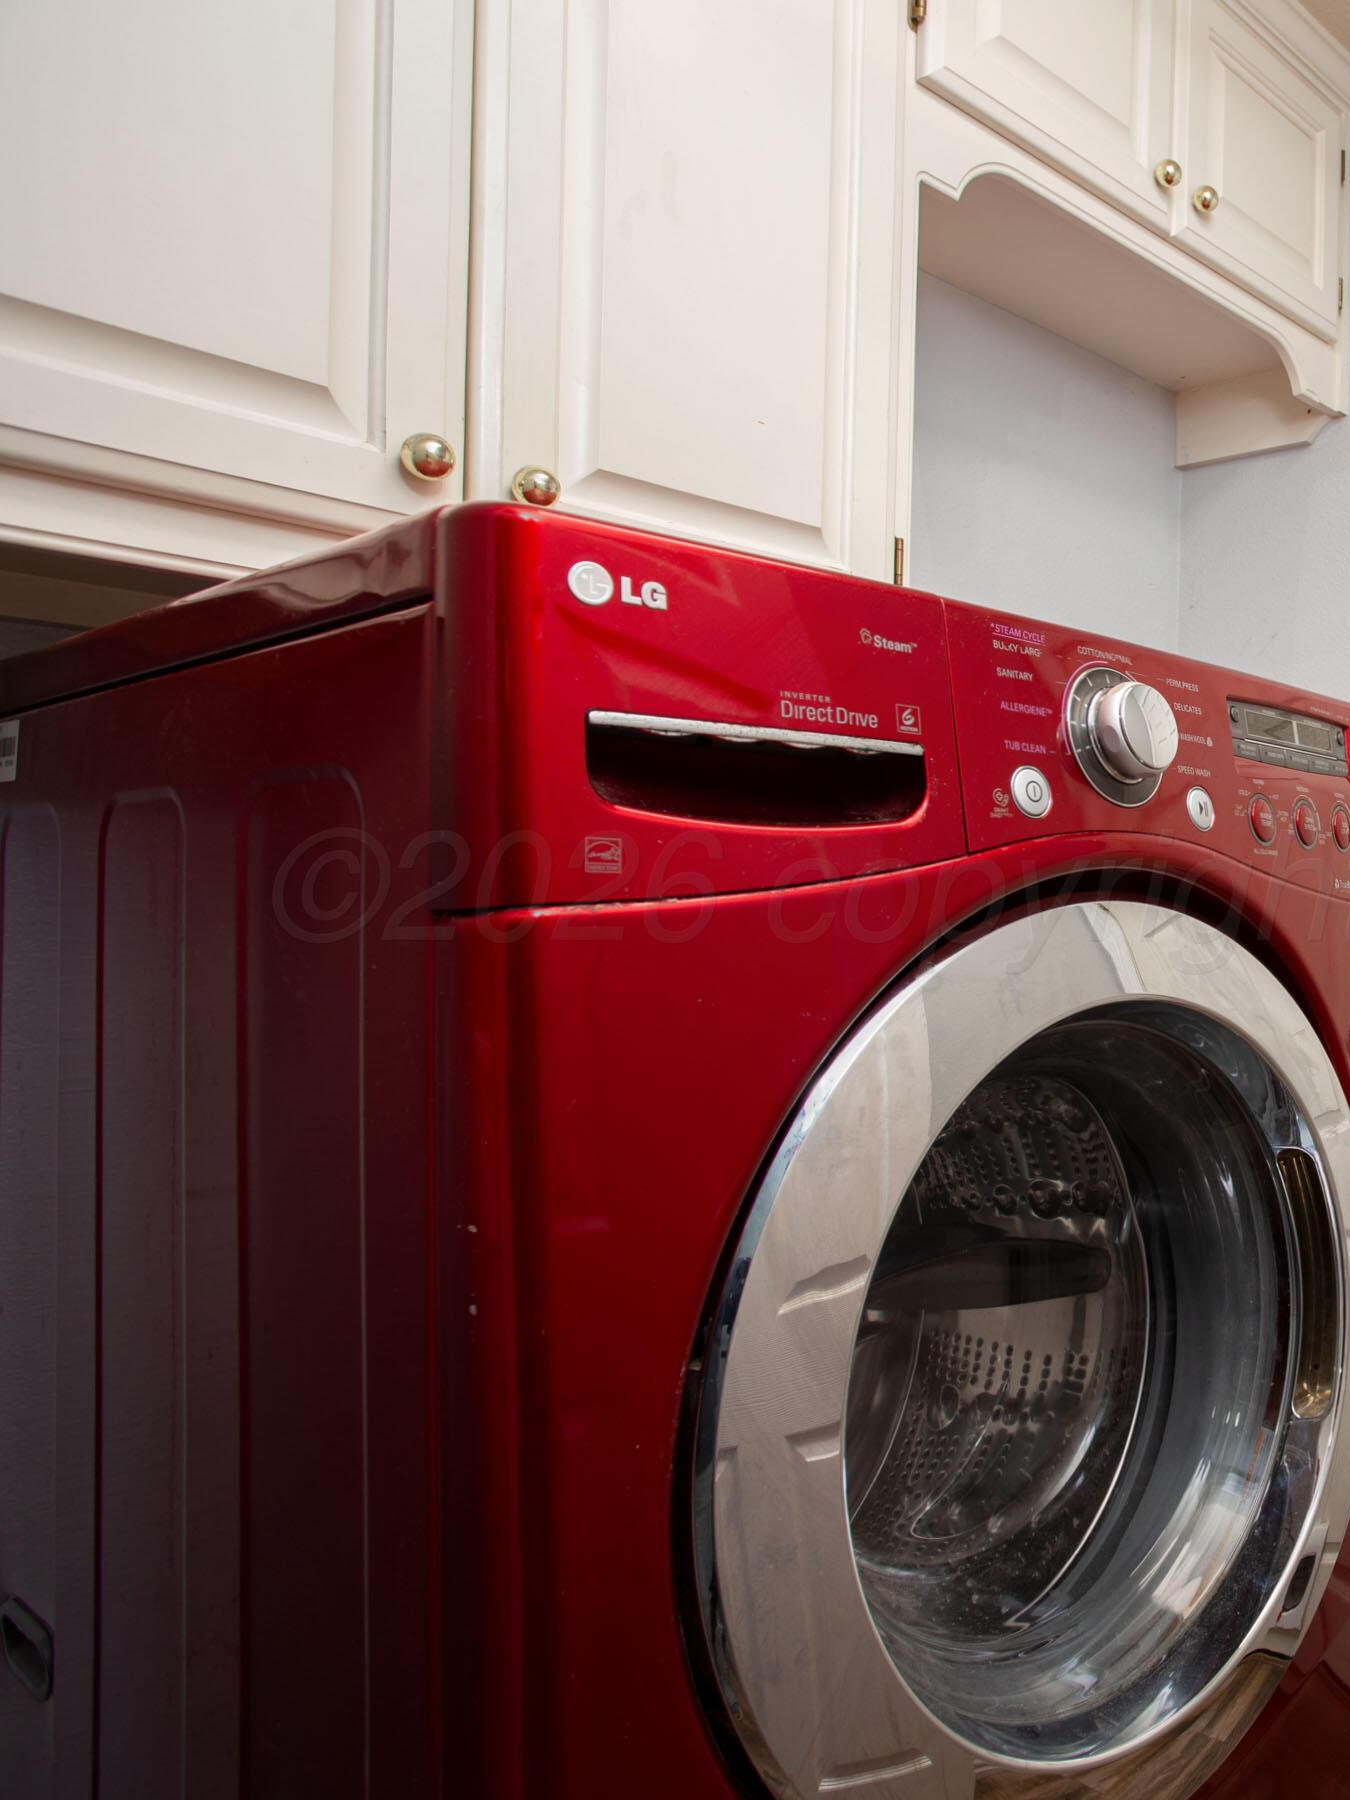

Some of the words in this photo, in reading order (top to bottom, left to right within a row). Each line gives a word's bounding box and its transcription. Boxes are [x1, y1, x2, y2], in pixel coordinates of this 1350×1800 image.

[620, 576, 667, 610] LG
[1022, 629, 1046, 643] CYCLE
[1020, 646, 1042, 657] LARG
[996, 666, 1033, 681] SANITARY
[780, 689, 831, 704] INVERTER
[780, 699, 834, 724] Direct
[835, 706, 878, 729] Drive
[1174, 702, 1202, 715] DELICATES
[1004, 739, 1021, 752] TUB
[1021, 742, 1046, 754] CLEAN
[1177, 765, 1194, 776] SPEED
[1194, 768, 1211, 777] WASH
